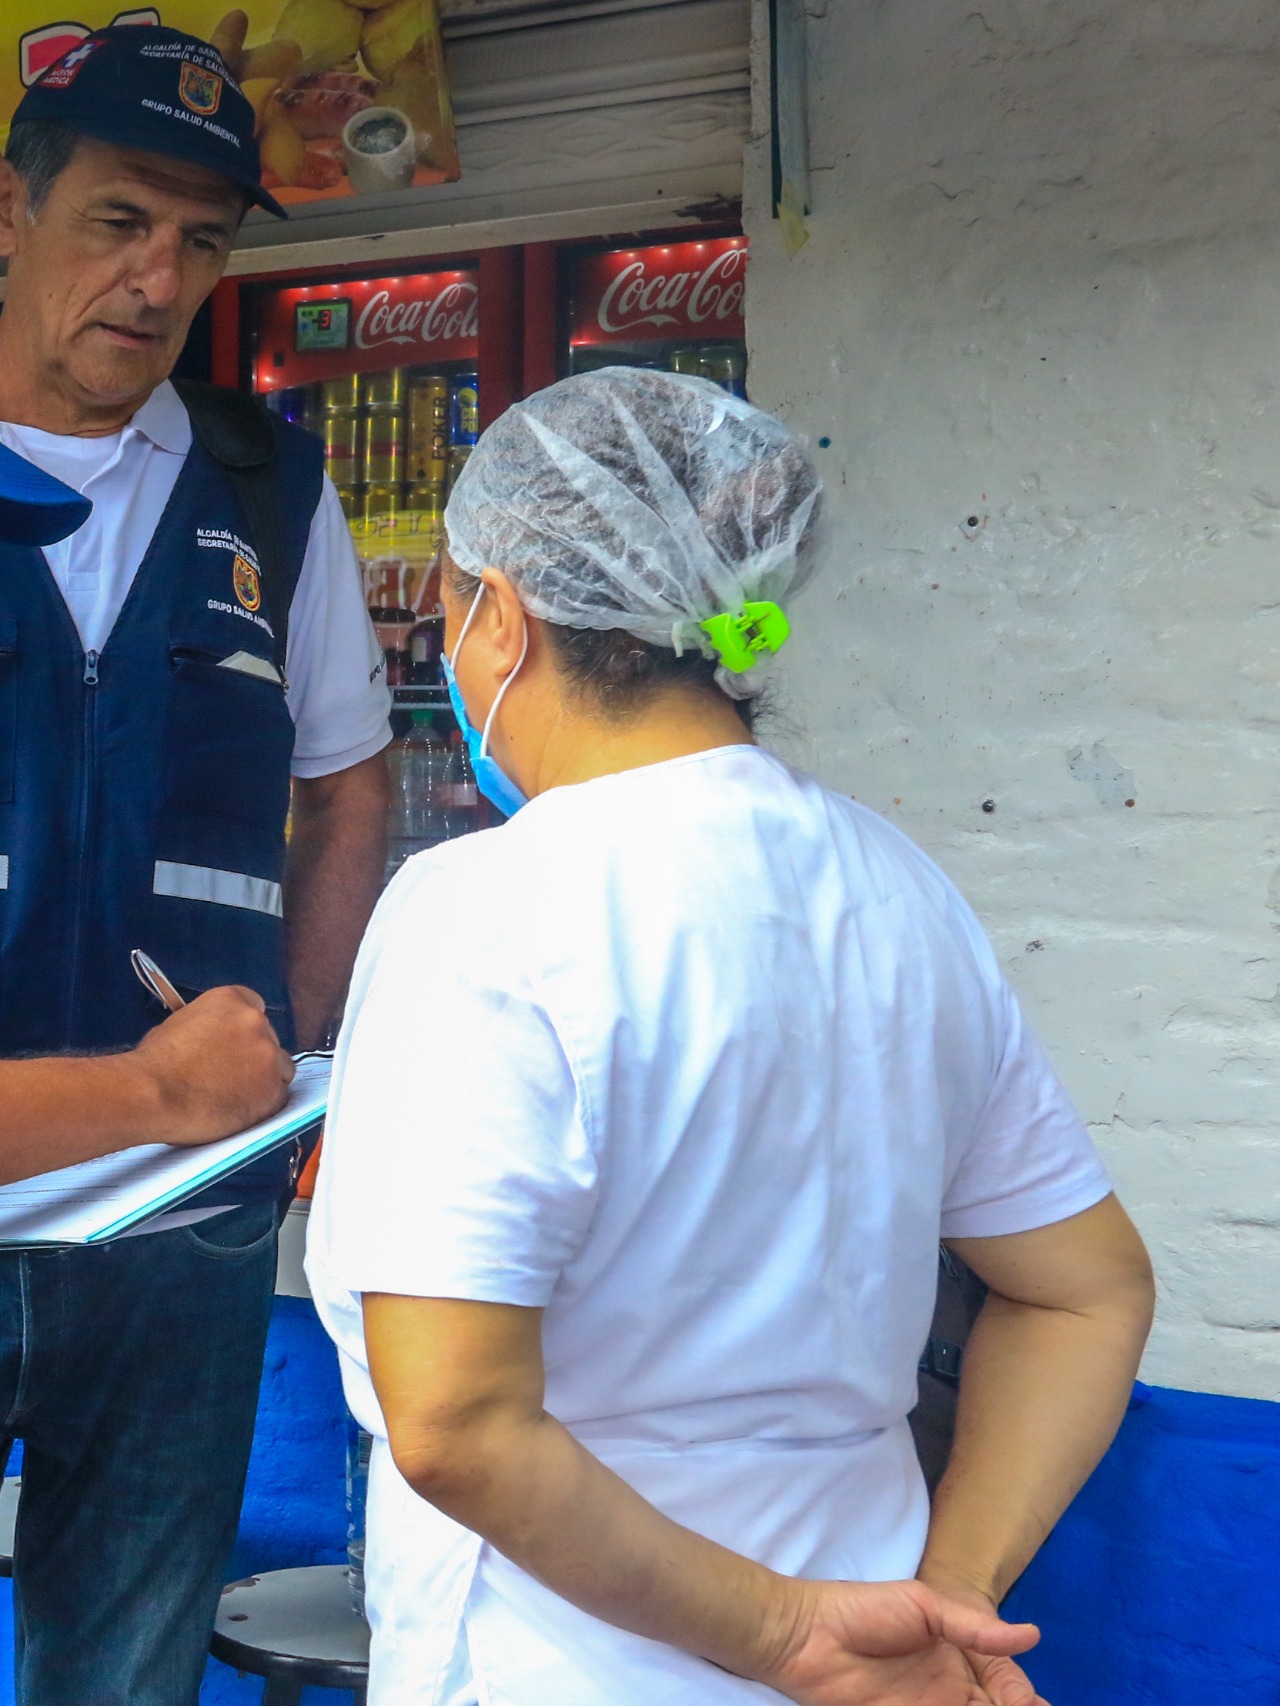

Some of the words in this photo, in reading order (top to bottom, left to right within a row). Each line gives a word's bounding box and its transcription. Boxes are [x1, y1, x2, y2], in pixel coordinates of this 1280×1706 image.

[192, 55, 204, 65] DE
[141, 98, 173, 115] GRUPO
[173, 109, 202, 126] SALUD
[203, 120, 241, 149] AMBIENTAL
[597, 248, 747, 334] Coca-Co
[431, 396, 447, 461] POKER
[196, 528, 232, 541] ALCALDÍA
[197, 538, 239, 553] SECRETARÍA
[207, 599, 232, 614] GRUPO
[232, 605, 254, 621] SALUD
